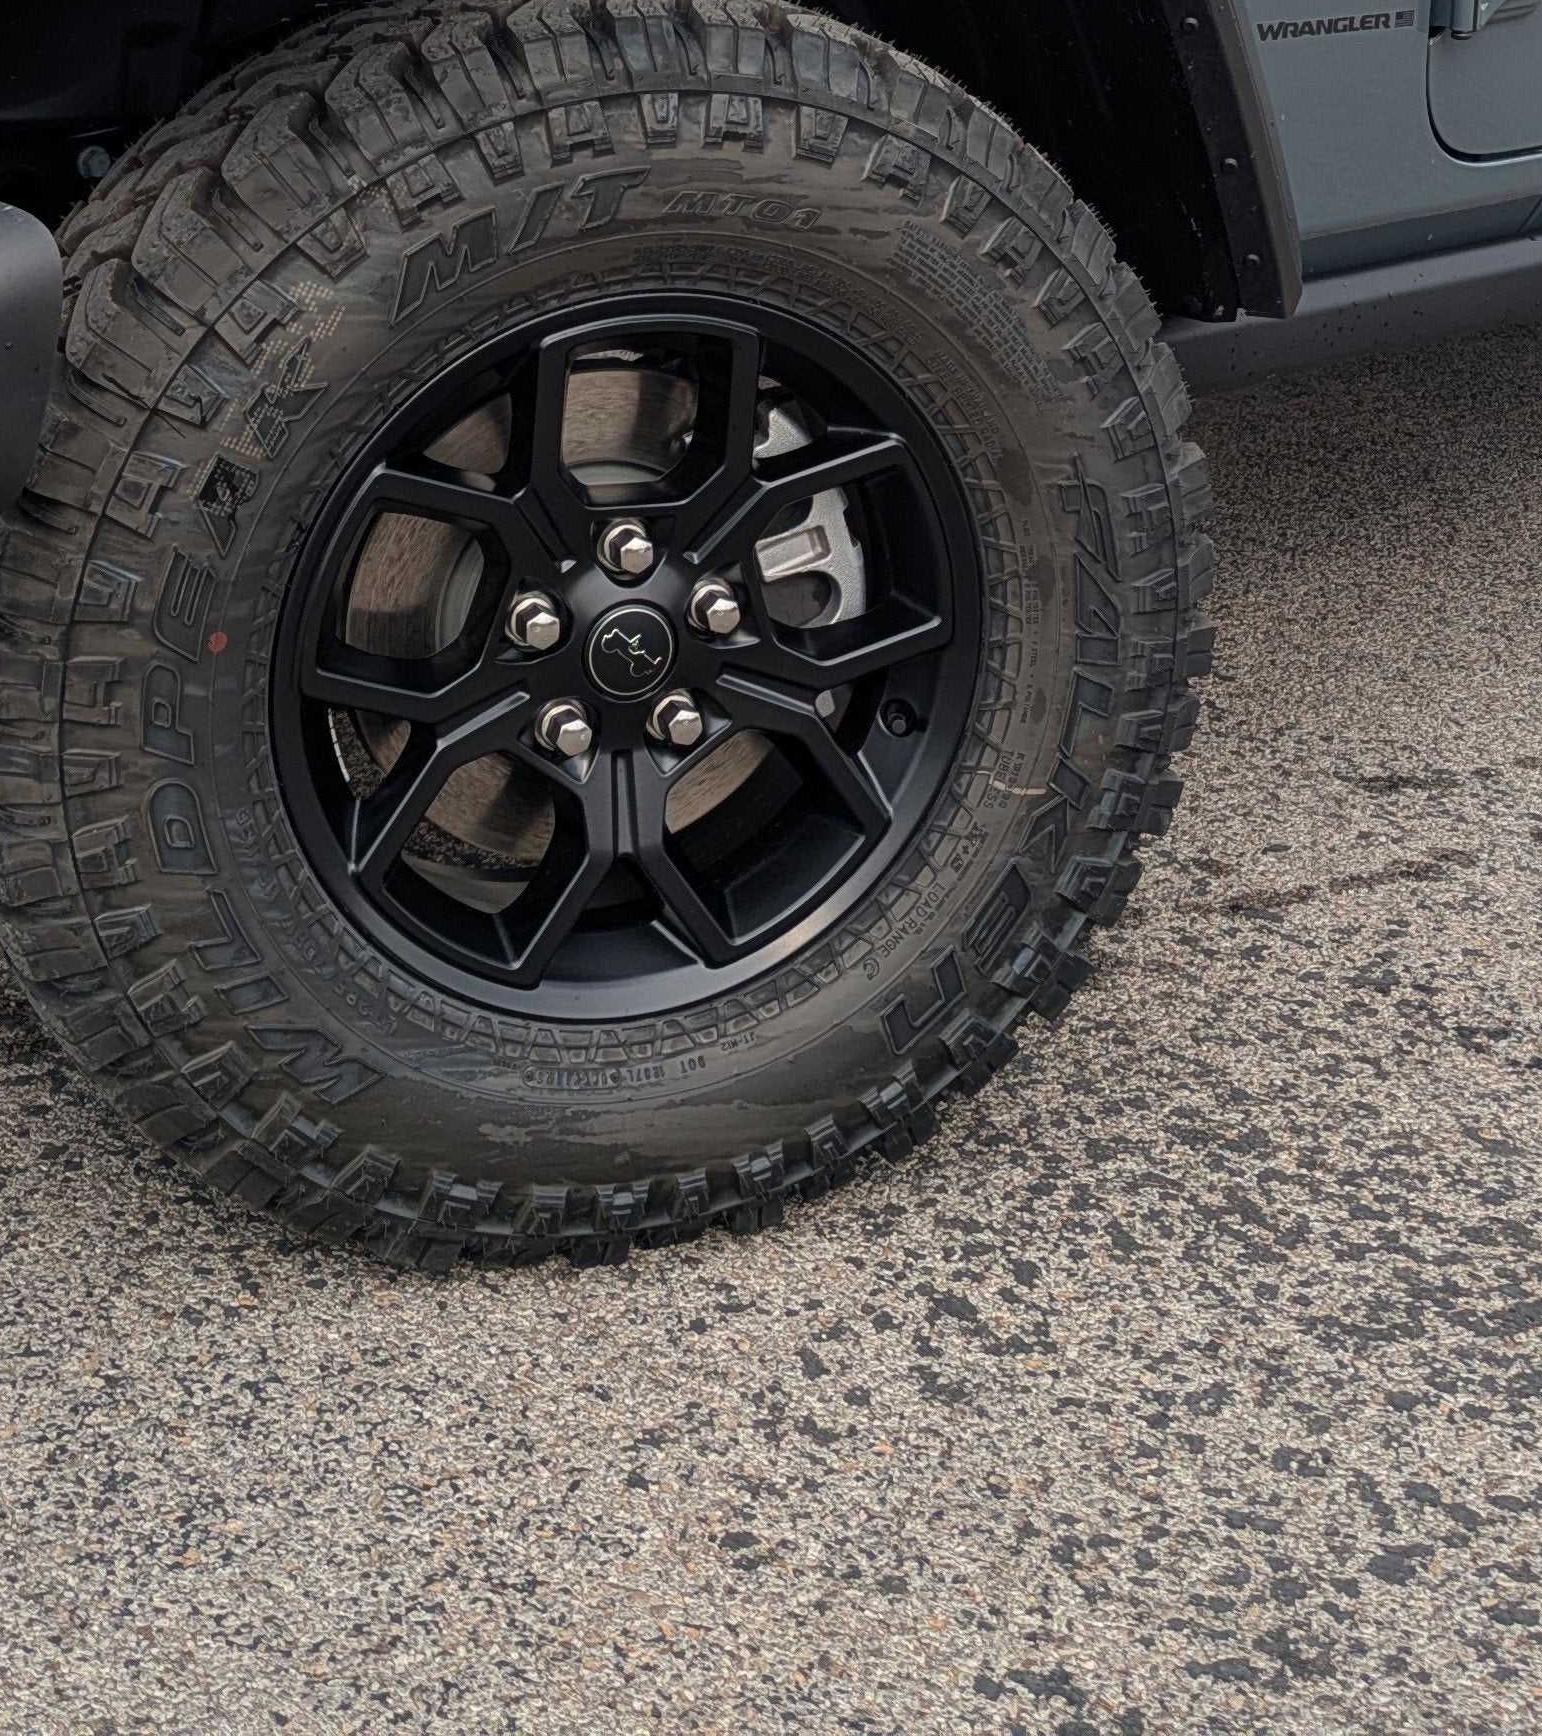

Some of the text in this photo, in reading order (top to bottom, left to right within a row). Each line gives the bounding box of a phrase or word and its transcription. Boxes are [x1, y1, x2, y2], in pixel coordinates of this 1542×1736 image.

[1257, 11, 1391, 41] WRANGLER
[663, 190, 825, 234] MT01
[880, 454, 1124, 1055] FALKEN
[913, 881, 946, 920] LOAD
[876, 915, 919, 959] RANGE
